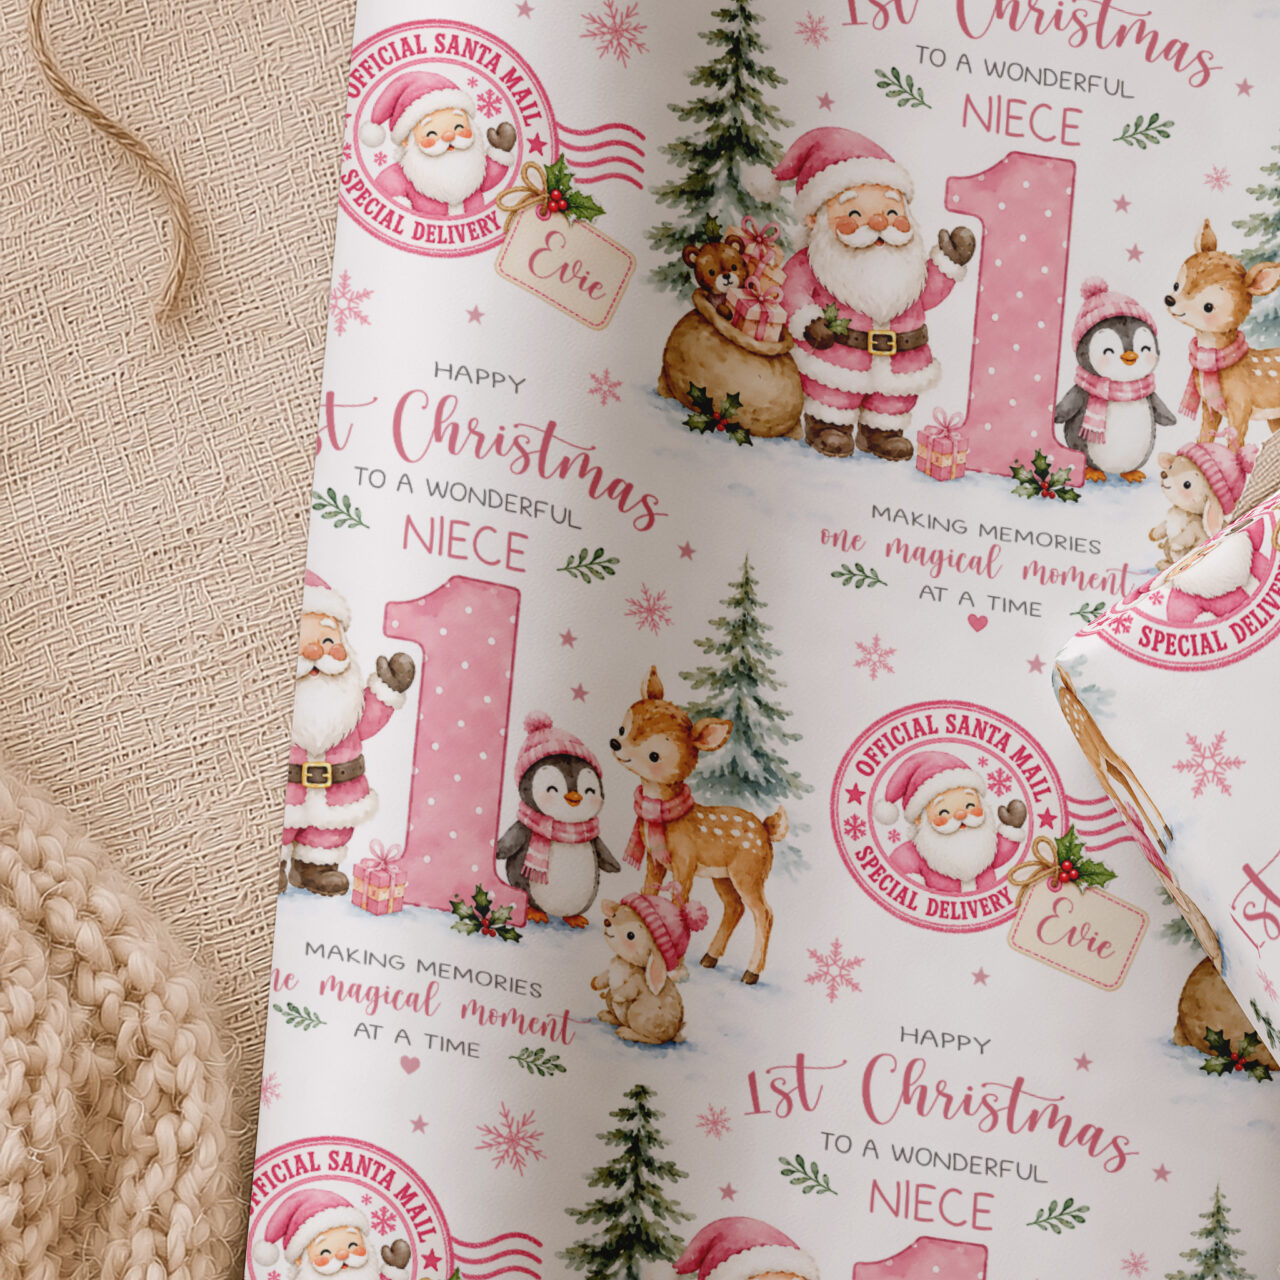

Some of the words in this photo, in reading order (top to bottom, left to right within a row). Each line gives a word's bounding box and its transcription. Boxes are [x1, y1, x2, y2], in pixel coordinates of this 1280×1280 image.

[434, 32, 502, 75] SANTA
[500, 66, 543, 128] MAIL
[915, 44, 947, 68] TO
[956, 52, 973, 74] A
[984, 58, 1136, 100] WONDERFUL
[962, 92, 1084, 147] NIECE
[340, 168, 404, 236] SPECIAL
[412, 210, 502, 245] DELIVERY
[528, 230, 608, 301] Evie
[434, 361, 526, 394] HAPPY
[392, 388, 669, 532] Christmas
[354, 466, 386, 489] TO
[396, 474, 414, 494] A
[426, 478, 582, 530] WONDERFUL
[402, 514, 528, 572] NIECE
[871, 504, 968, 534] MAKING
[978, 523, 1102, 555] MEMORIES
[820, 528, 866, 552] one
[885, 538, 1003, 579] magical
[1022, 560, 1150, 598] moment
[918, 585, 948, 602] AT
[958, 591, 975, 608] A
[988, 594, 1042, 618] TIME
[1138, 624, 1228, 658] SPECIAL
[855, 714, 939, 778] OFFICIAL
[945, 713, 1011, 752] SANTA
[1008, 744, 1054, 803] MAIL
[855, 845, 919, 912] SPECIAL
[925, 885, 1014, 922] DELIVERY
[1036, 896, 1116, 961] Evie
[305, 942, 405, 971] MAKING
[416, 958, 542, 998] MEMORIES
[318, 974, 441, 1017] magical
[460, 998, 592, 1046] moment
[354, 1022, 384, 1040] AT
[394, 1028, 412, 1046] A
[424, 1032, 480, 1059] TIME
[900, 1026, 992, 1056] HAPPY
[744, 1052, 848, 1120] 1st
[862, 1052, 1140, 1174] Christmas
[820, 1130, 852, 1154] TO
[862, 1139, 879, 1160] A
[891, 1143, 1048, 1184] WONDERFUL
[250, 1151, 321, 1216] FFICIAL
[328, 1150, 401, 1192] SANTA
[394, 1182, 437, 1244] MAIL
[869, 1178, 996, 1231] NIECE
